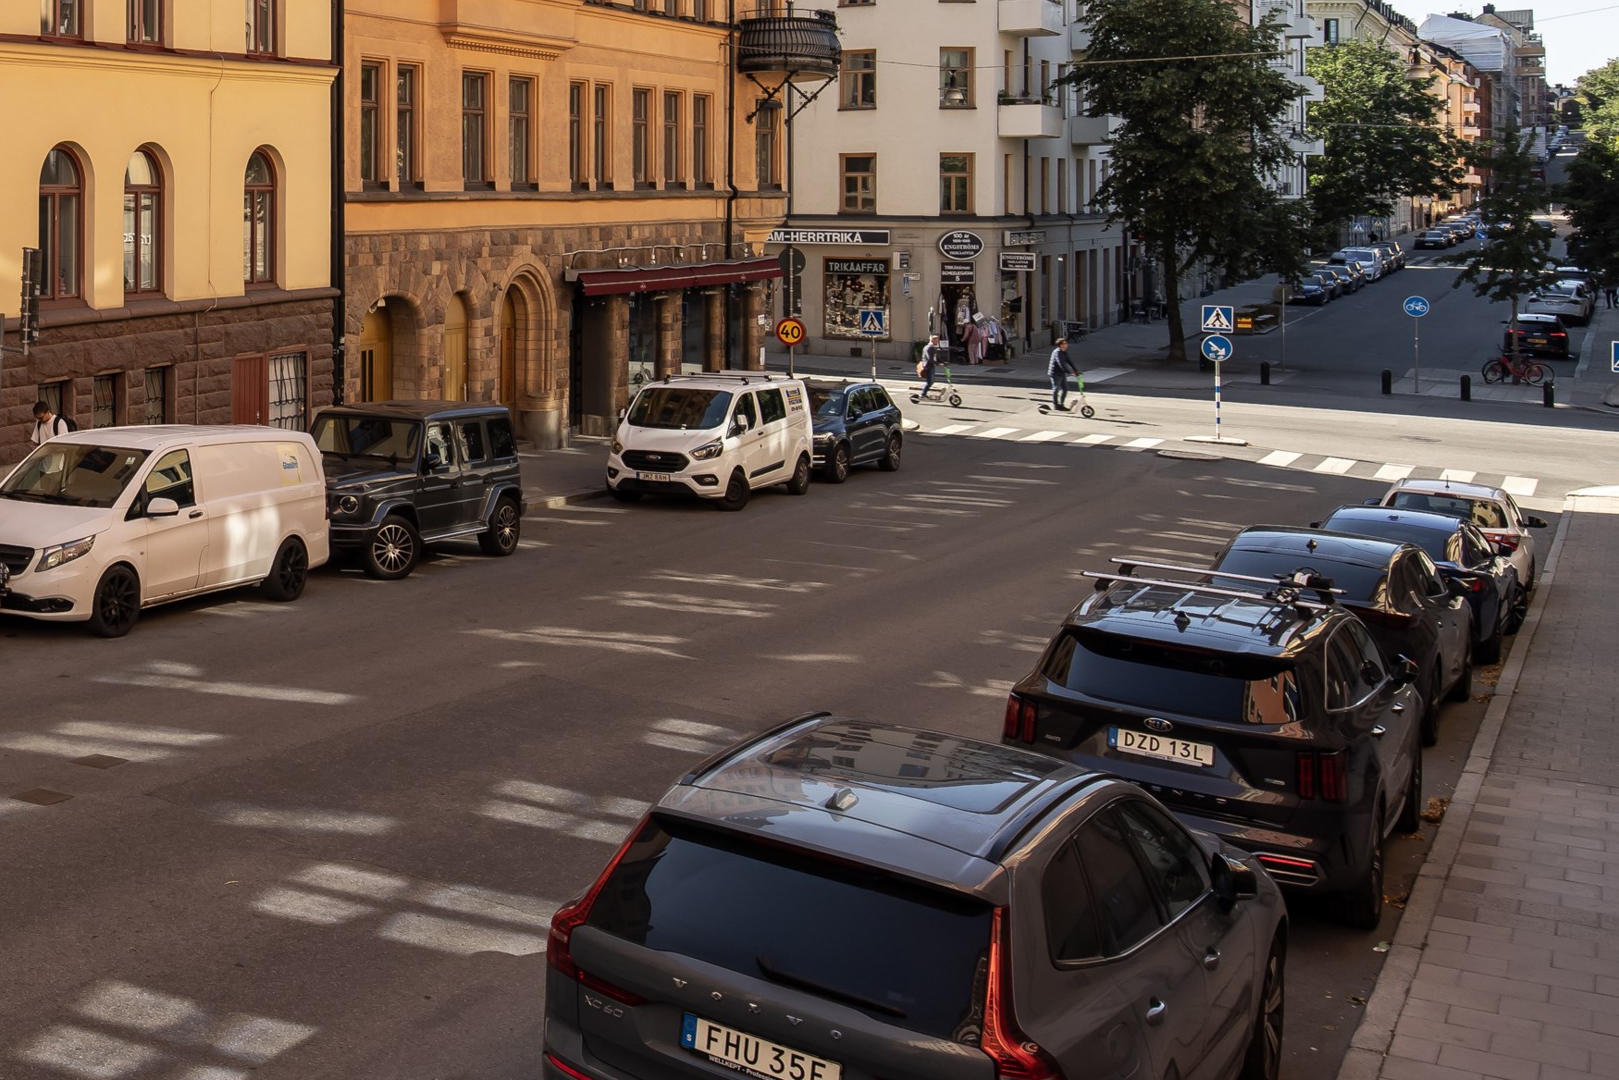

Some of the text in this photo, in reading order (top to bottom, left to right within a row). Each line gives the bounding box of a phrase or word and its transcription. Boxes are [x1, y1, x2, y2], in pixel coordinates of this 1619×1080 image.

[767, 231, 863, 243] AM-HERRTRIKÅ
[829, 261, 885, 273] TRIKÅAFFÄR
[781, 324, 801, 339] 40
[1124, 732, 1160, 752] DZD
[1170, 740, 1204, 761] 13L
[672, 977, 842, 1039] VOLVO
[706, 1025, 760, 1065] FHU
[708, 1055, 742, 1072] WELLKEPT
